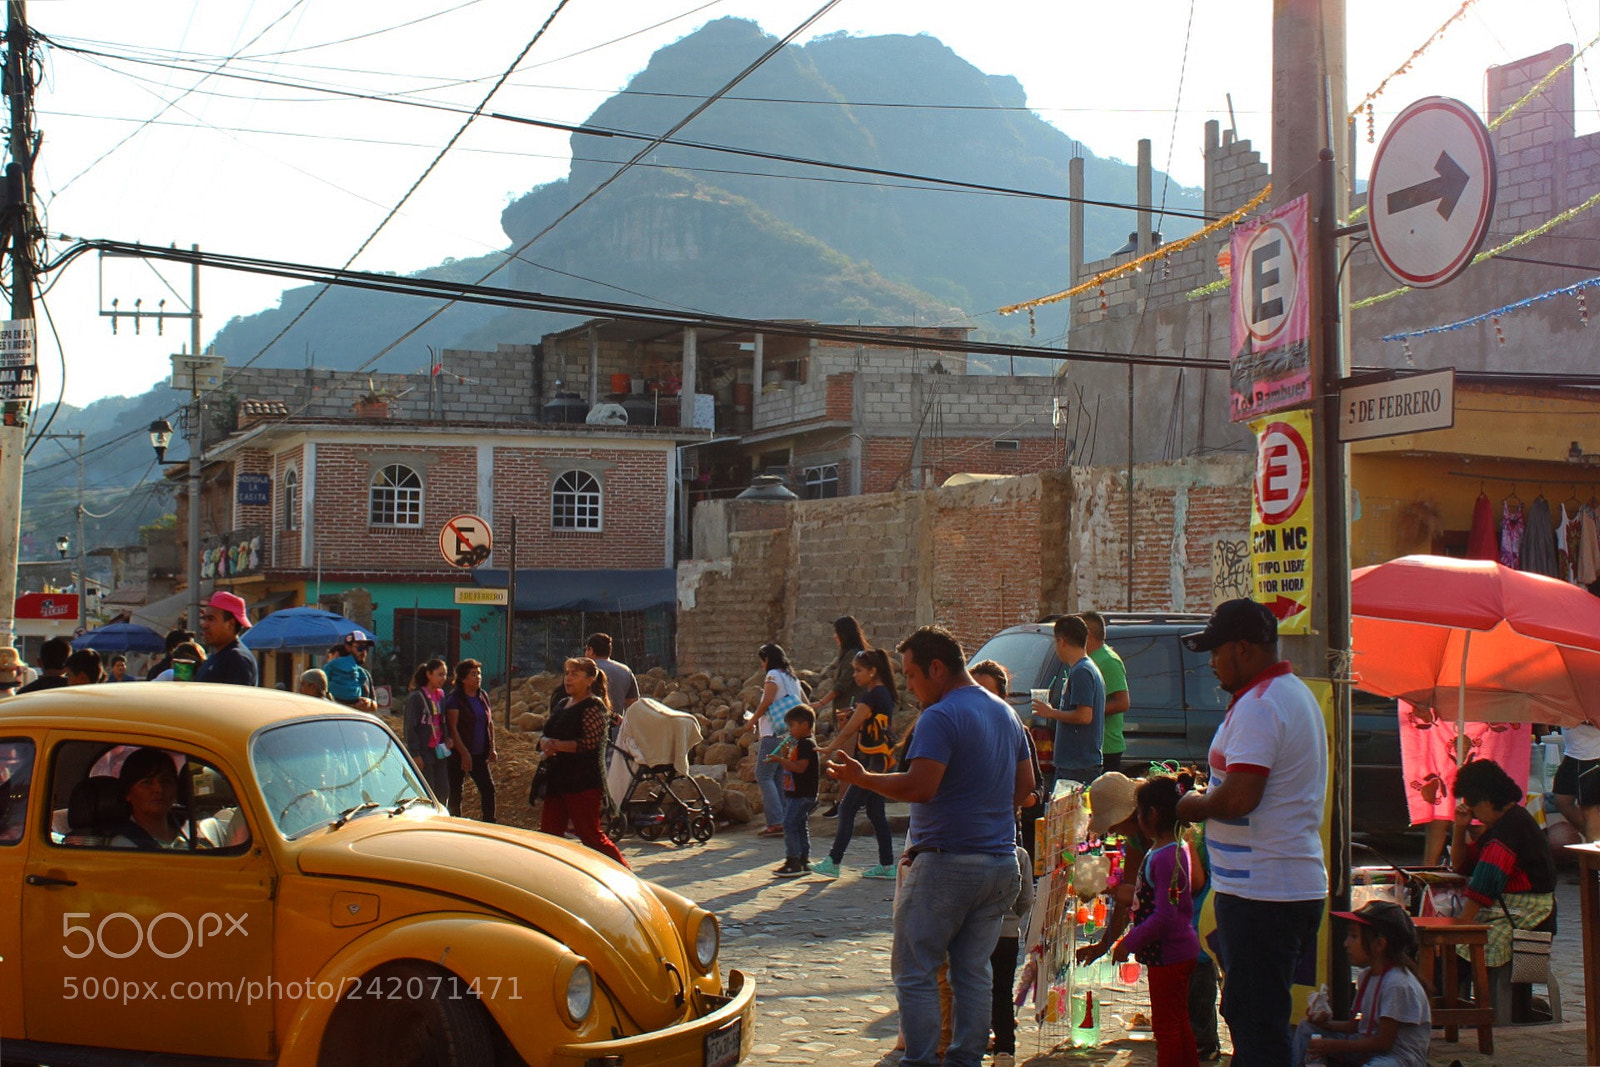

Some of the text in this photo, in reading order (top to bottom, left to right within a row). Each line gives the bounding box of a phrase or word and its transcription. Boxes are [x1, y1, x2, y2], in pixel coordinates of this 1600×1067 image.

[1252, 238, 1284, 325] E
[1349, 388, 1441, 424] 5 DE FEBRERO
[1263, 444, 1289, 502] E
[1282, 526, 1307, 551] WC
